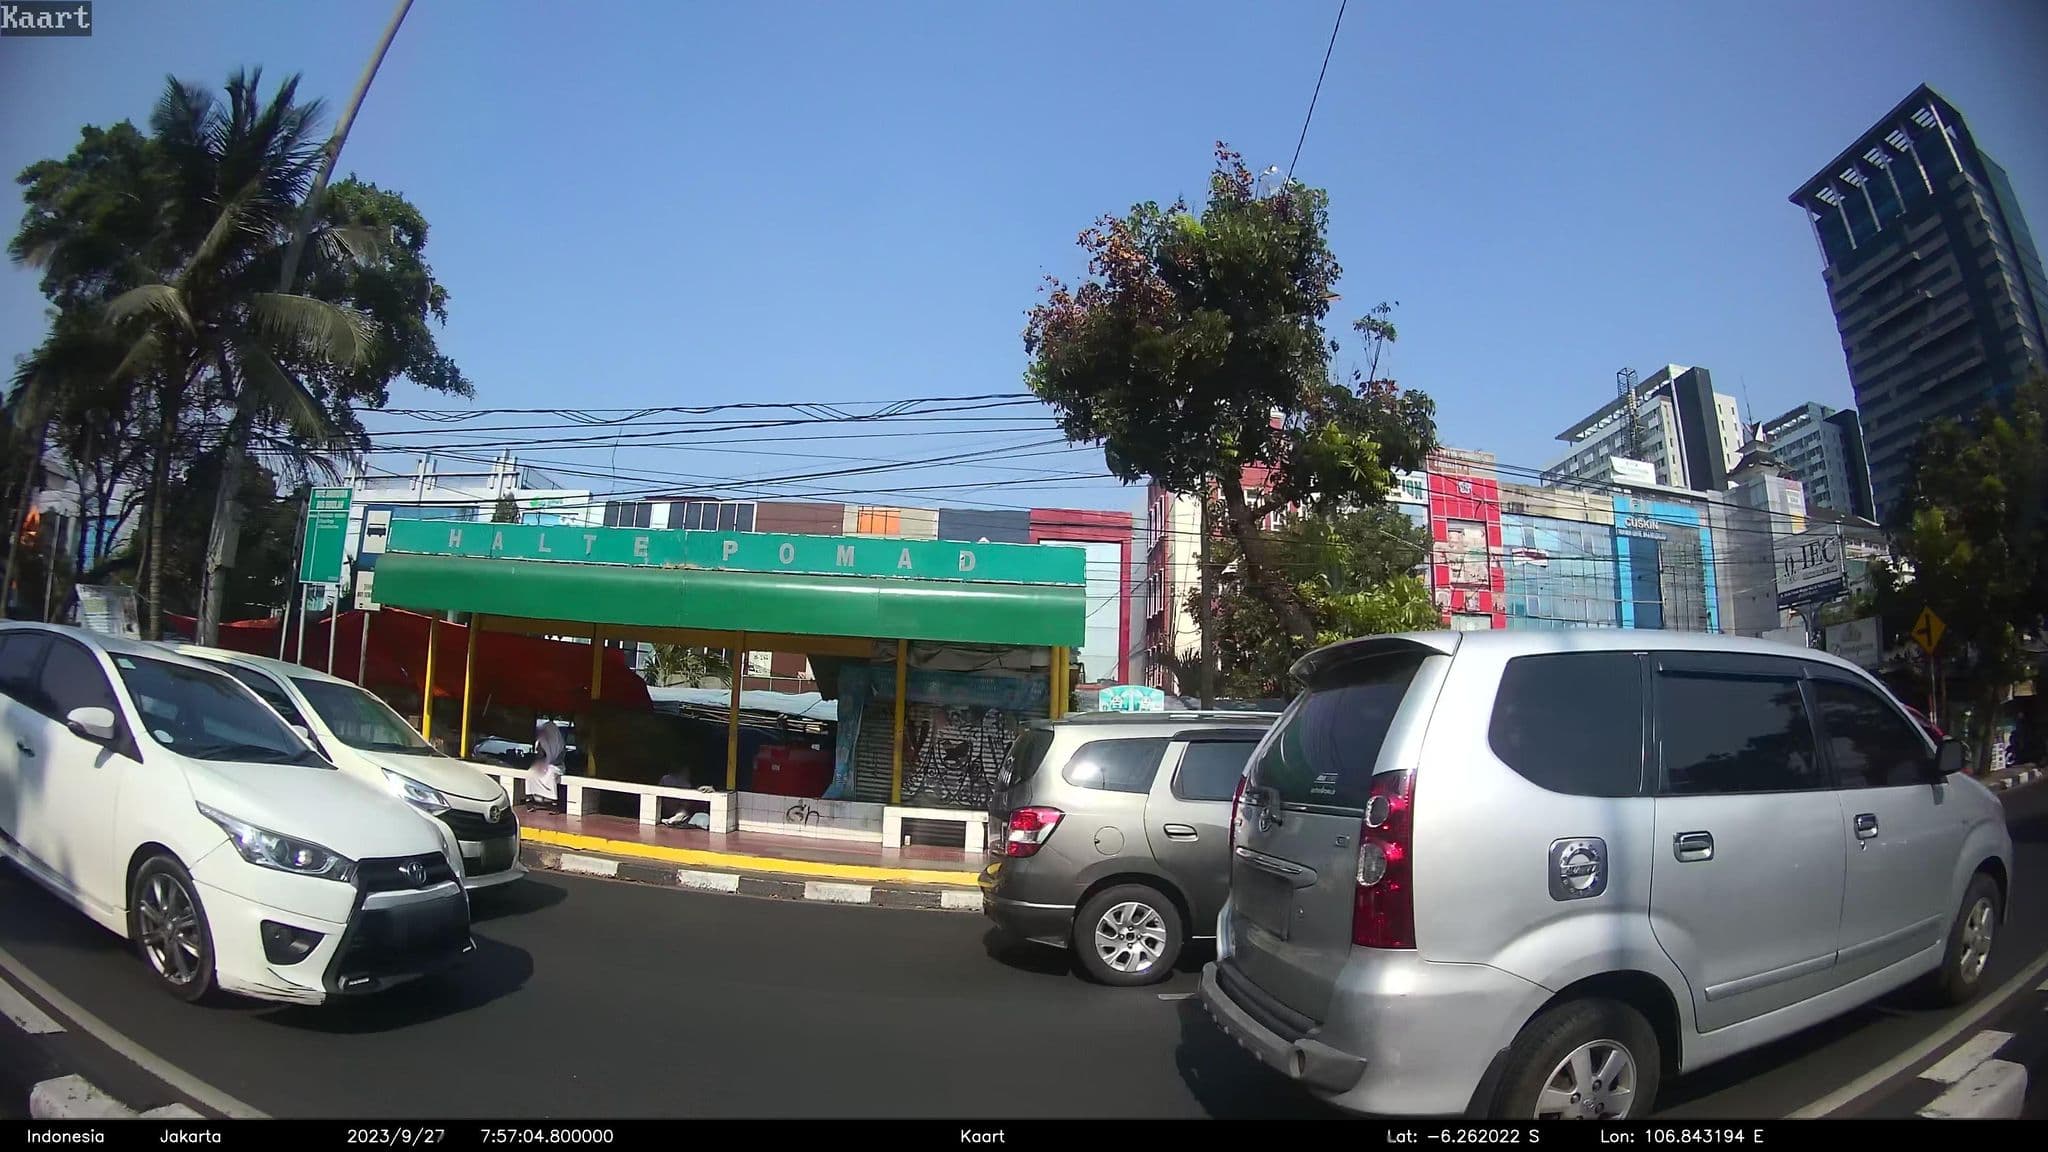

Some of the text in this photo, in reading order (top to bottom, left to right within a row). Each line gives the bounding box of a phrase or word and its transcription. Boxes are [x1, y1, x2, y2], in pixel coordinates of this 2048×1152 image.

[448, 528, 977, 573] HALTE POMAD
[1801, 536, 1837, 570] IEC
